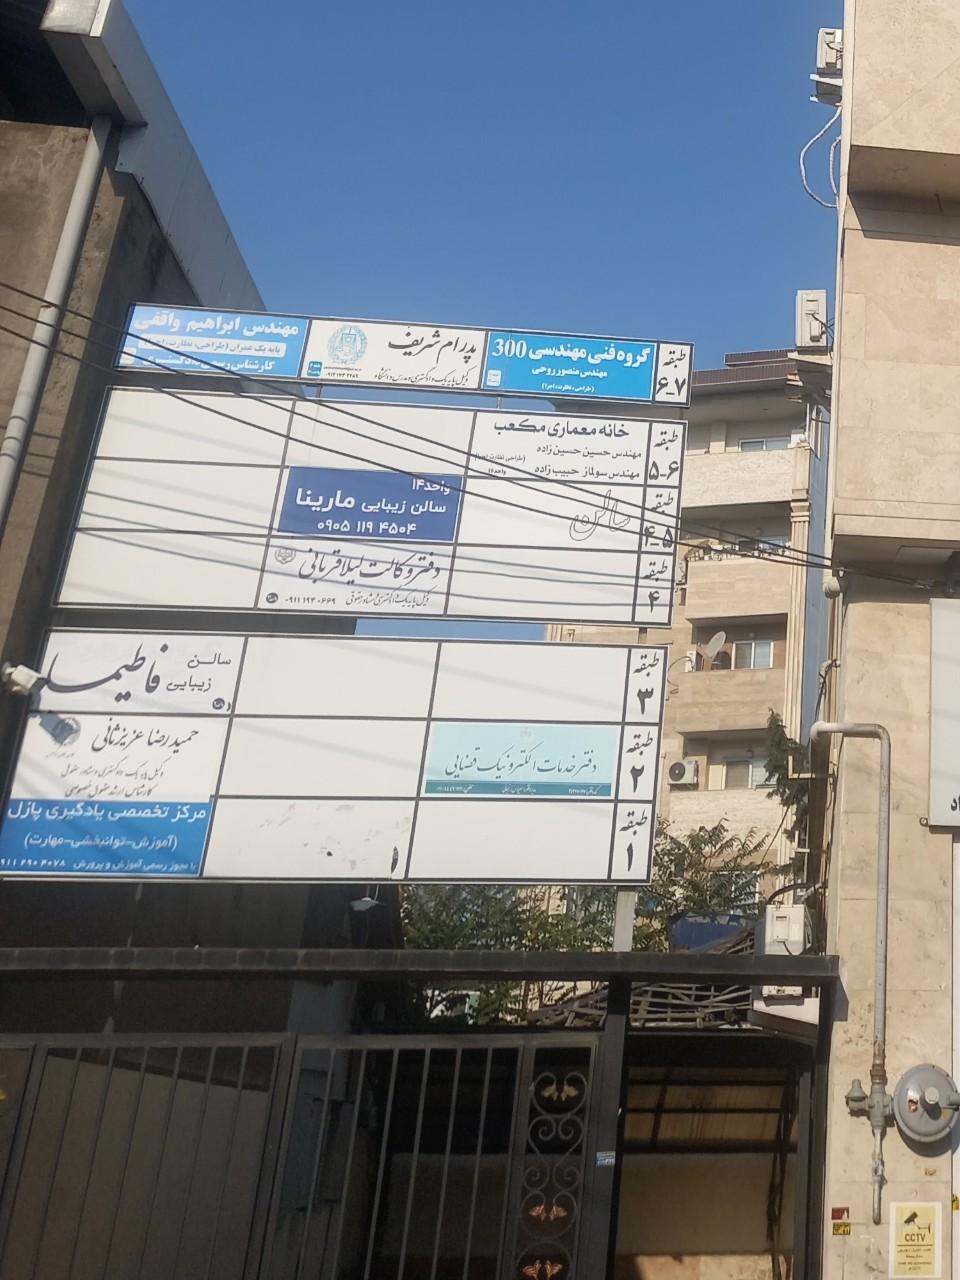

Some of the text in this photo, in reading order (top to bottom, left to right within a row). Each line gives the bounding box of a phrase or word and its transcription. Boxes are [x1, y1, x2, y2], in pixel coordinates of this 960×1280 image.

[134, 308, 299, 337] مهندس ابراهیم واقفی
[388, 329, 441, 357] شریف
[491, 338, 651, 368] گروه فنی مهندسی 300
[663, 348, 687, 368] طبقه
[531, 365, 608, 378] مهندس منصور روحی
[494, 418, 630, 438] خانه معماری مکعب
[653, 429, 679, 451] طبقه
[582, 448, 610, 458] حسین
[611, 450, 642, 459] مهندس
[582, 467, 608, 478] سولماز
[608, 470, 640, 479] مهندس
[295, 487, 446, 516] سالن زیبایی مارینا
[650, 490, 675, 514] طبقه
[317, 519, 417, 535] ۰۹۰۵ ۱۱۹ ۴۵۰۴
[405, 551, 441, 586] دفتر
[640, 560, 668, 581] طبقه
[648, 590, 661, 614] ۴
[187, 652, 232, 669] سالن
[633, 651, 660, 677] طبقه
[166, 675, 212, 691] زیبایی
[637, 687, 654, 715] ۳
[626, 731, 653, 756] طبقه
[477, 741, 544, 779] الکترونیک
[537, 755, 577, 773] خدمات
[572, 749, 597, 777] دفتر
[630, 765, 645, 793] ۲
[8, 801, 206, 823] مرکز تخصصی یادگیری پازل
[619, 808, 648, 835] طبقه
[627, 842, 635, 872] ۱
[904, 1233, 926, 1242] CCTV
